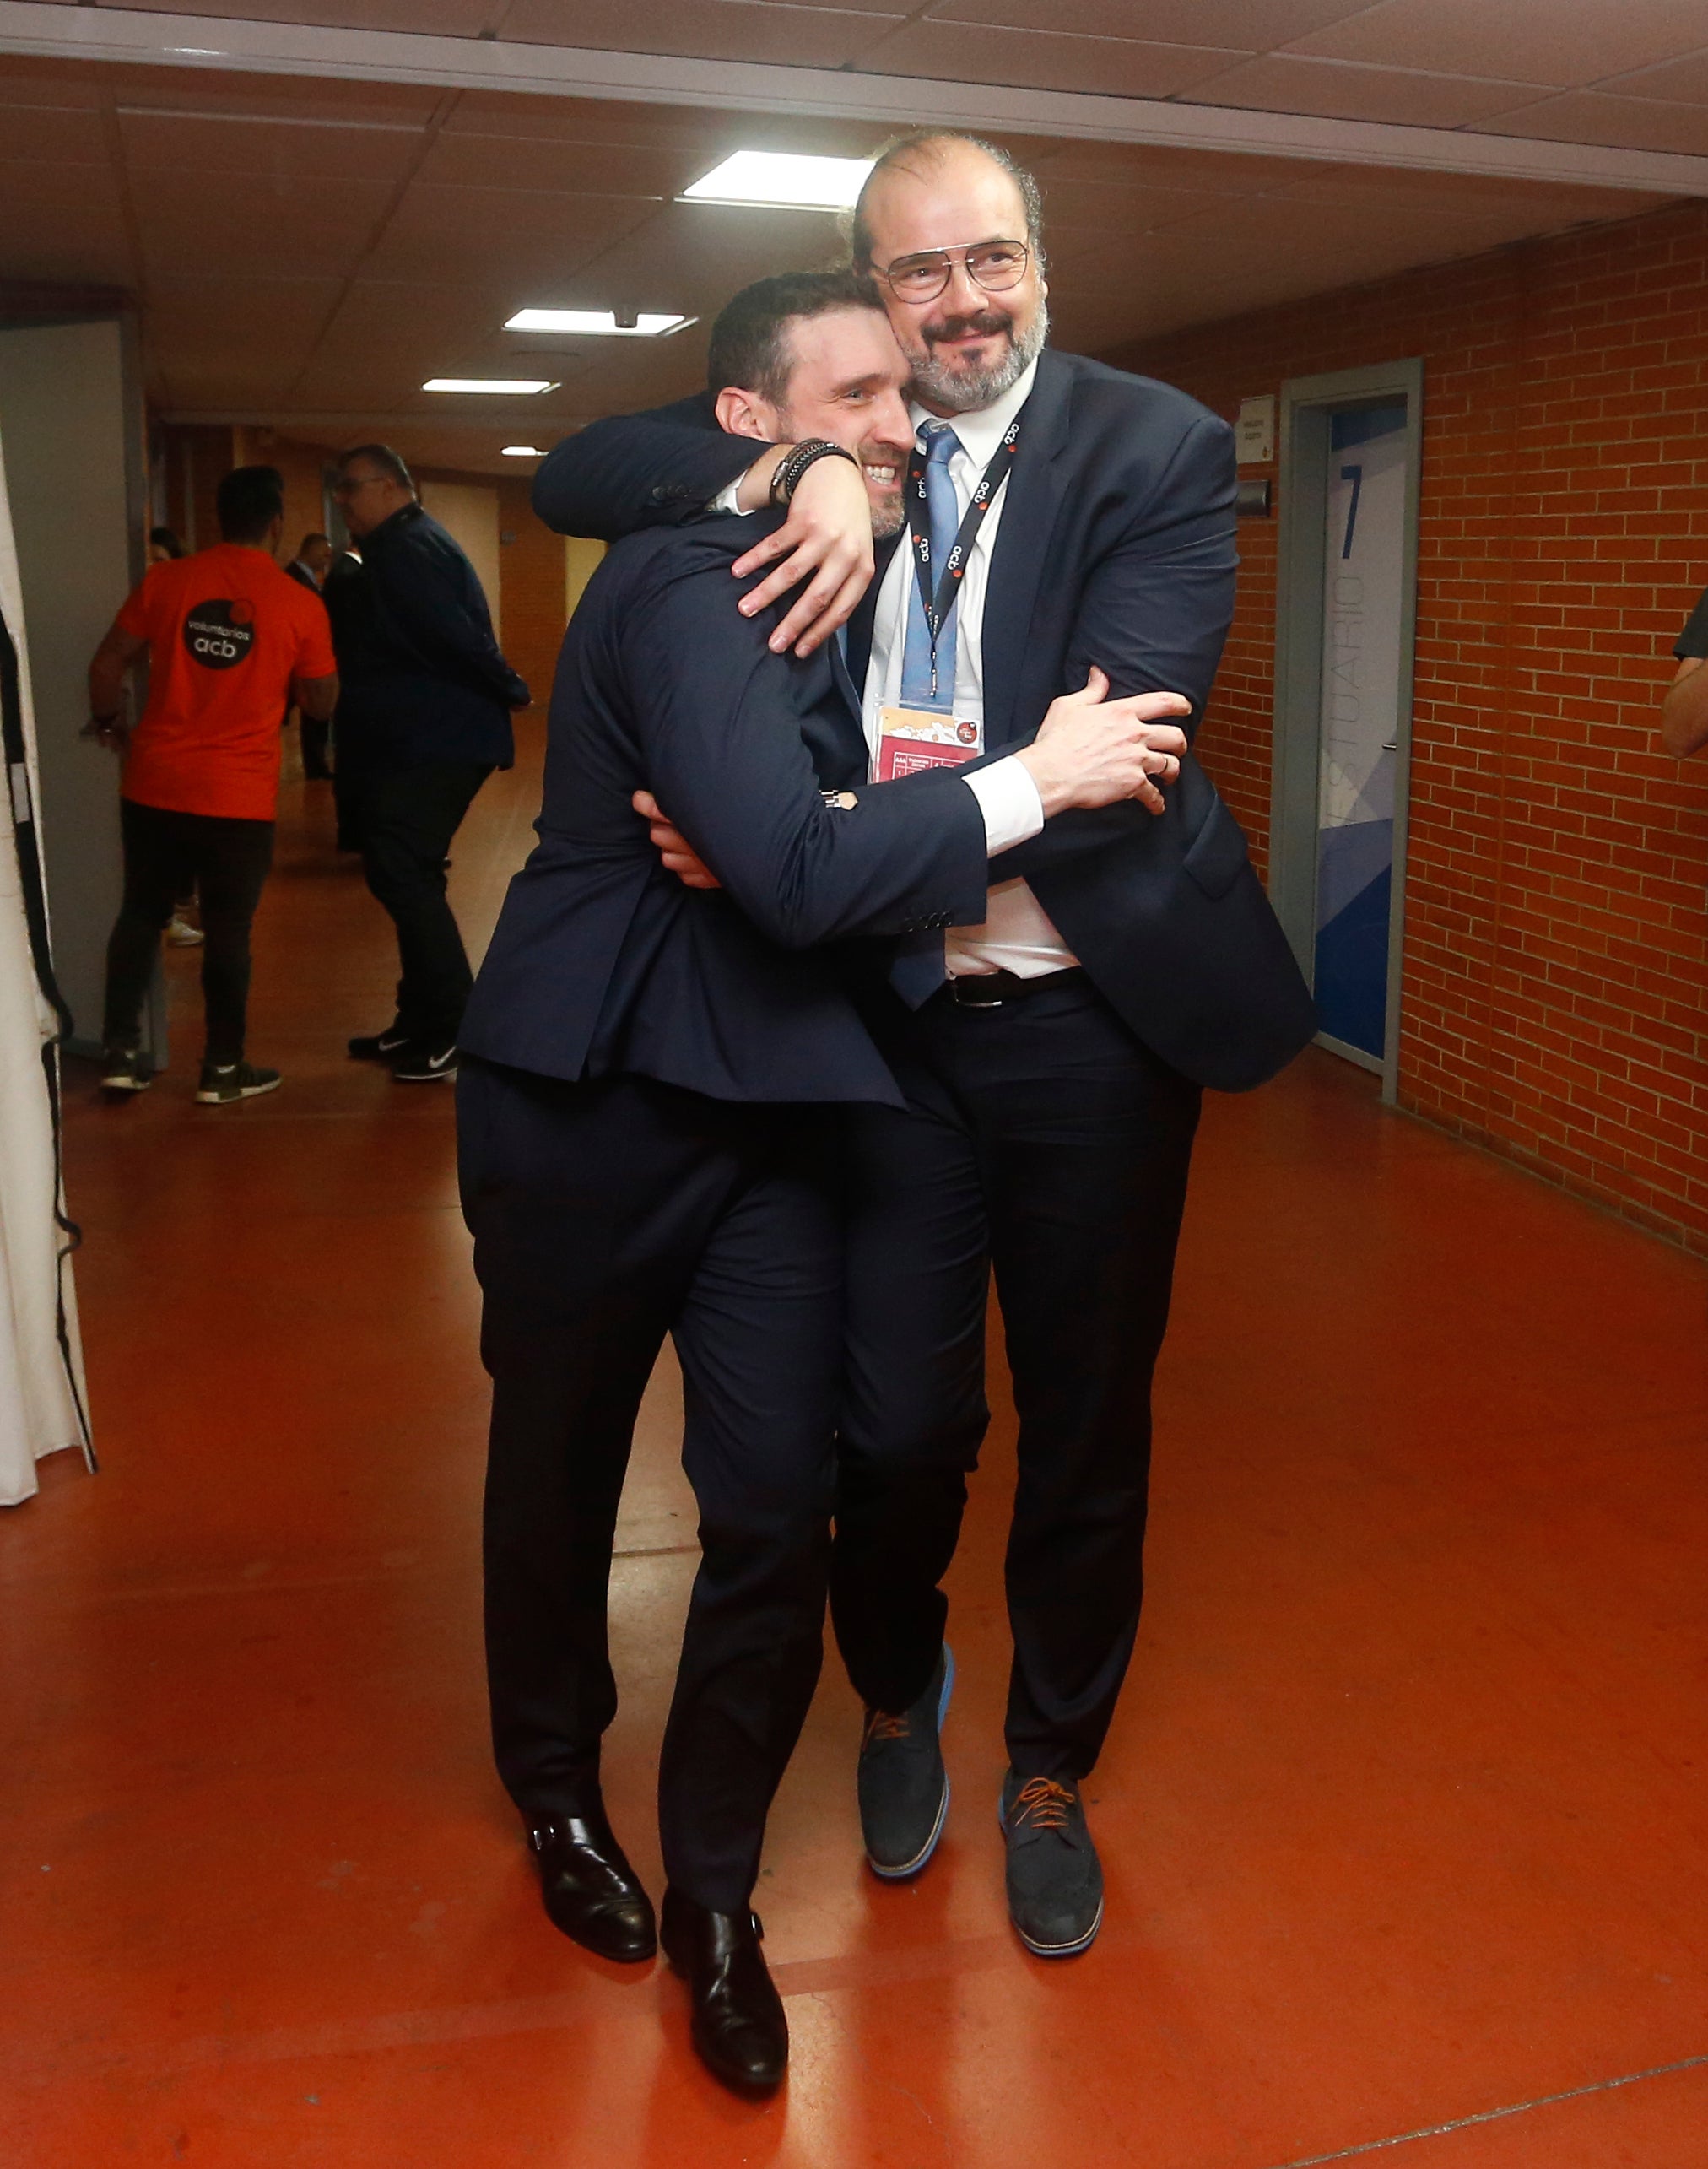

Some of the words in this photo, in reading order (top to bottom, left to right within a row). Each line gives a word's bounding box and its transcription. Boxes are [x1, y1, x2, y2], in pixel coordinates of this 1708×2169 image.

[1004, 424, 1019, 445] acb
[974, 481, 990, 503] acb
[1340, 465, 1363, 559] 7
[919, 538, 929, 562] acb
[948, 545, 962, 571] acb
[194, 638, 236, 658] acb
